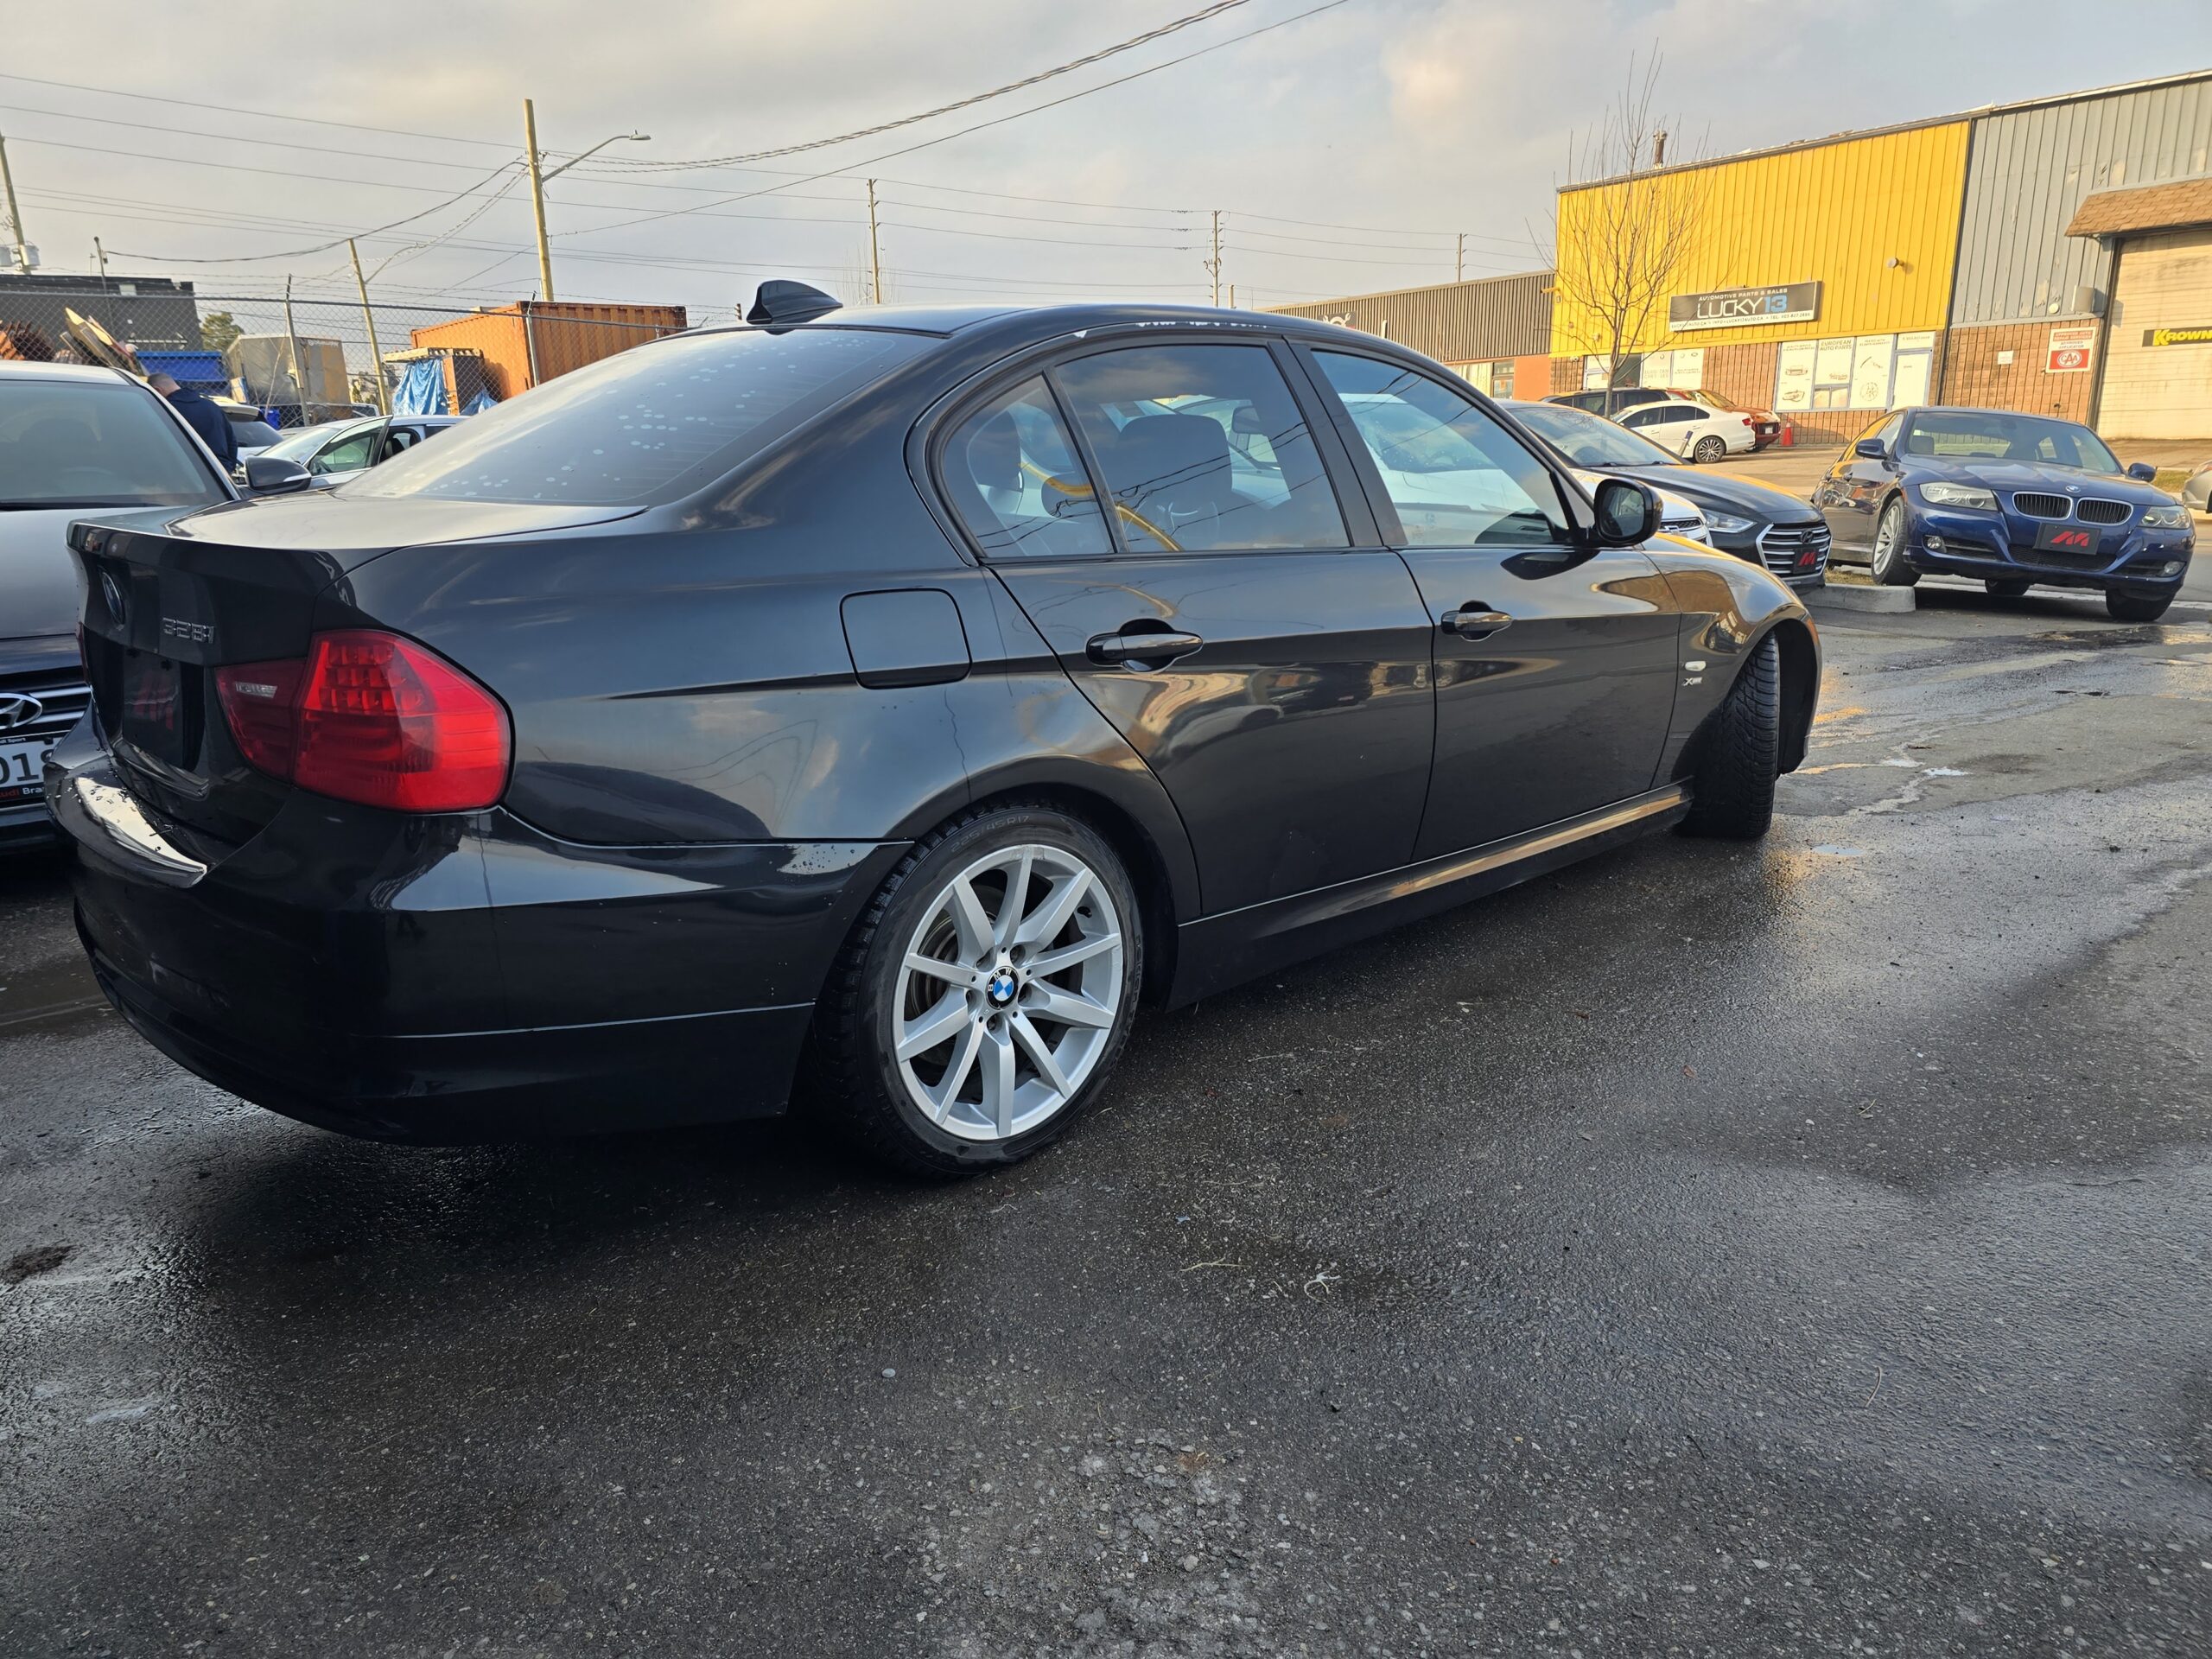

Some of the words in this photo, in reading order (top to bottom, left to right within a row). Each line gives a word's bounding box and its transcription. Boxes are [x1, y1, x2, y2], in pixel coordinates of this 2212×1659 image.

[1699, 293, 1737, 302] AUTOMOTIVE
[2152, 328, 2212, 346] KROWN
[2061, 353, 2078, 365] CAA
[22, 786, 45, 795] Bra
[988, 968, 1013, 992] BMW
